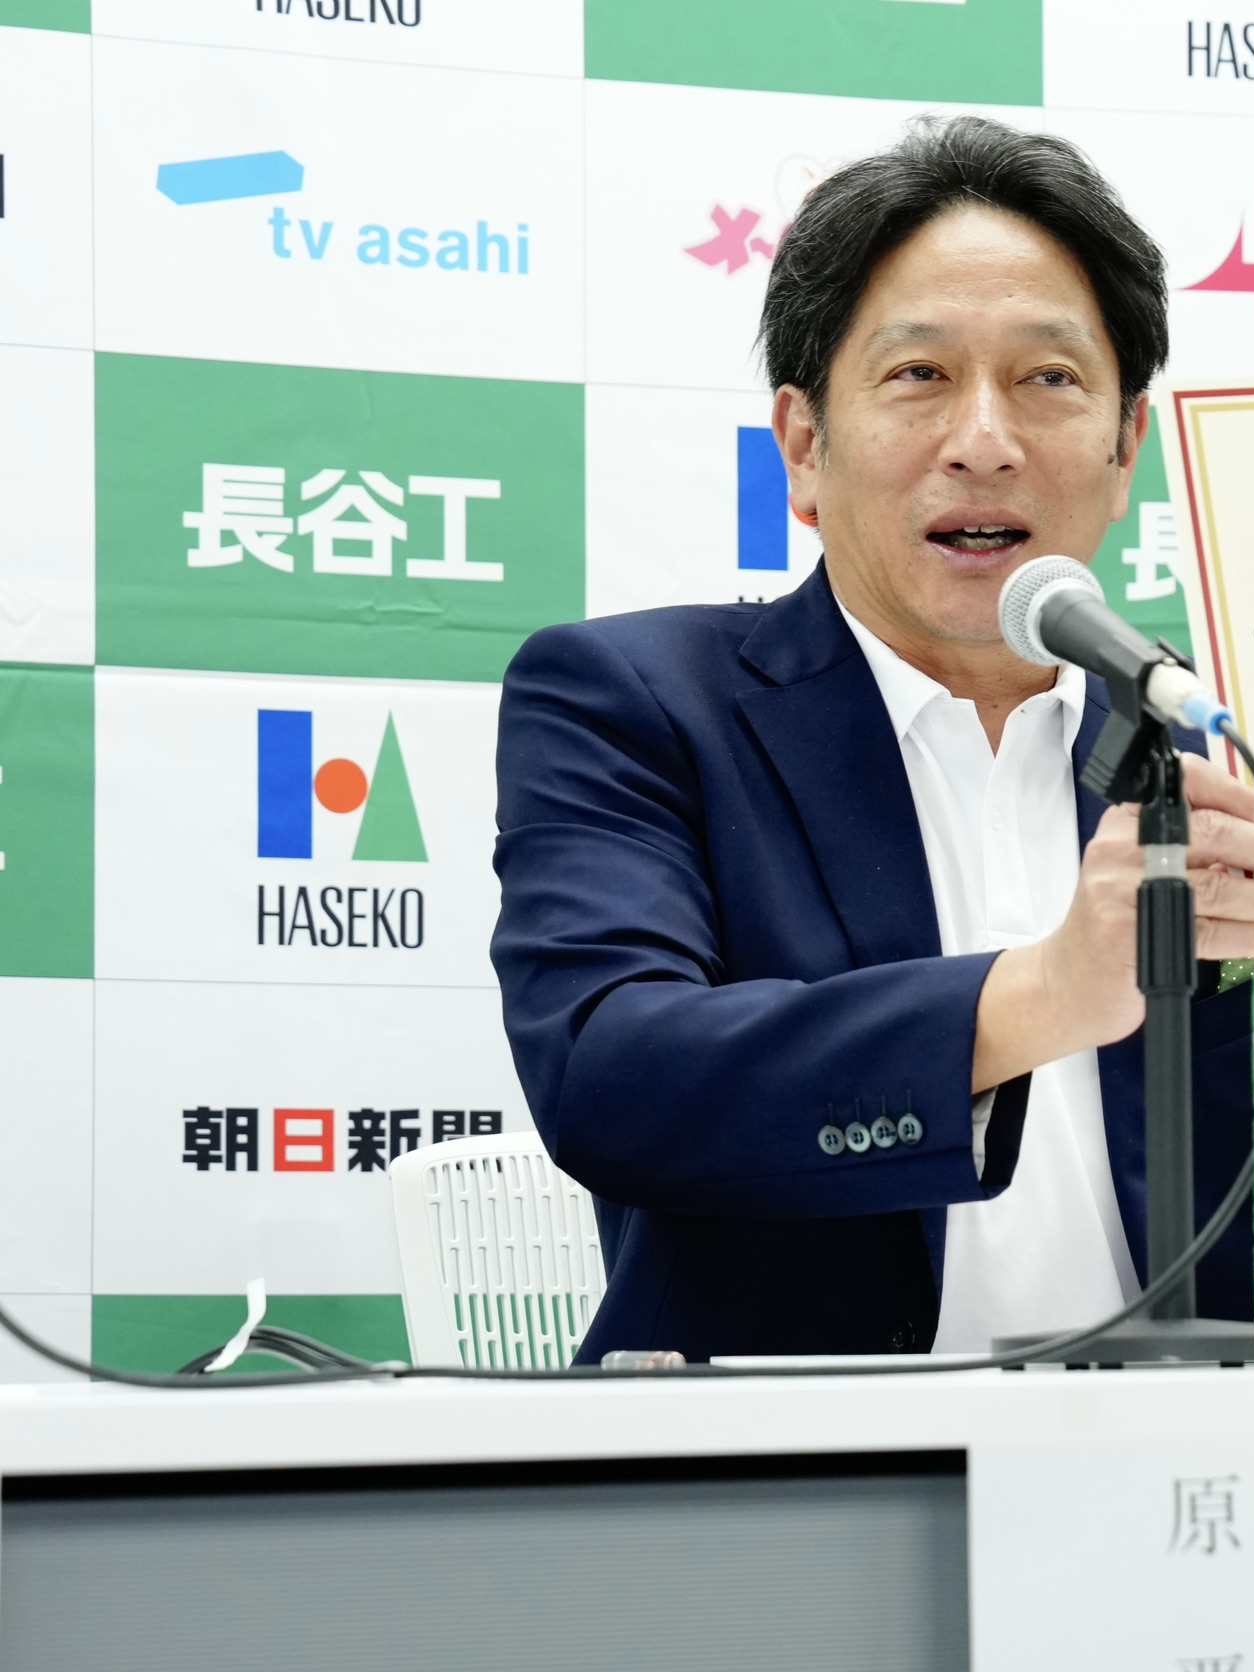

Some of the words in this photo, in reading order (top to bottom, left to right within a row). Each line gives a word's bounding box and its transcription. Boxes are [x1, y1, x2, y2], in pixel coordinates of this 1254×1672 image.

[267, 207, 335, 261] tv
[356, 219, 531, 275] asahi
[182, 463, 505, 582] 長谷工
[256, 884, 425, 949] HASEKO
[1168, 1473, 1242, 1556] 原
